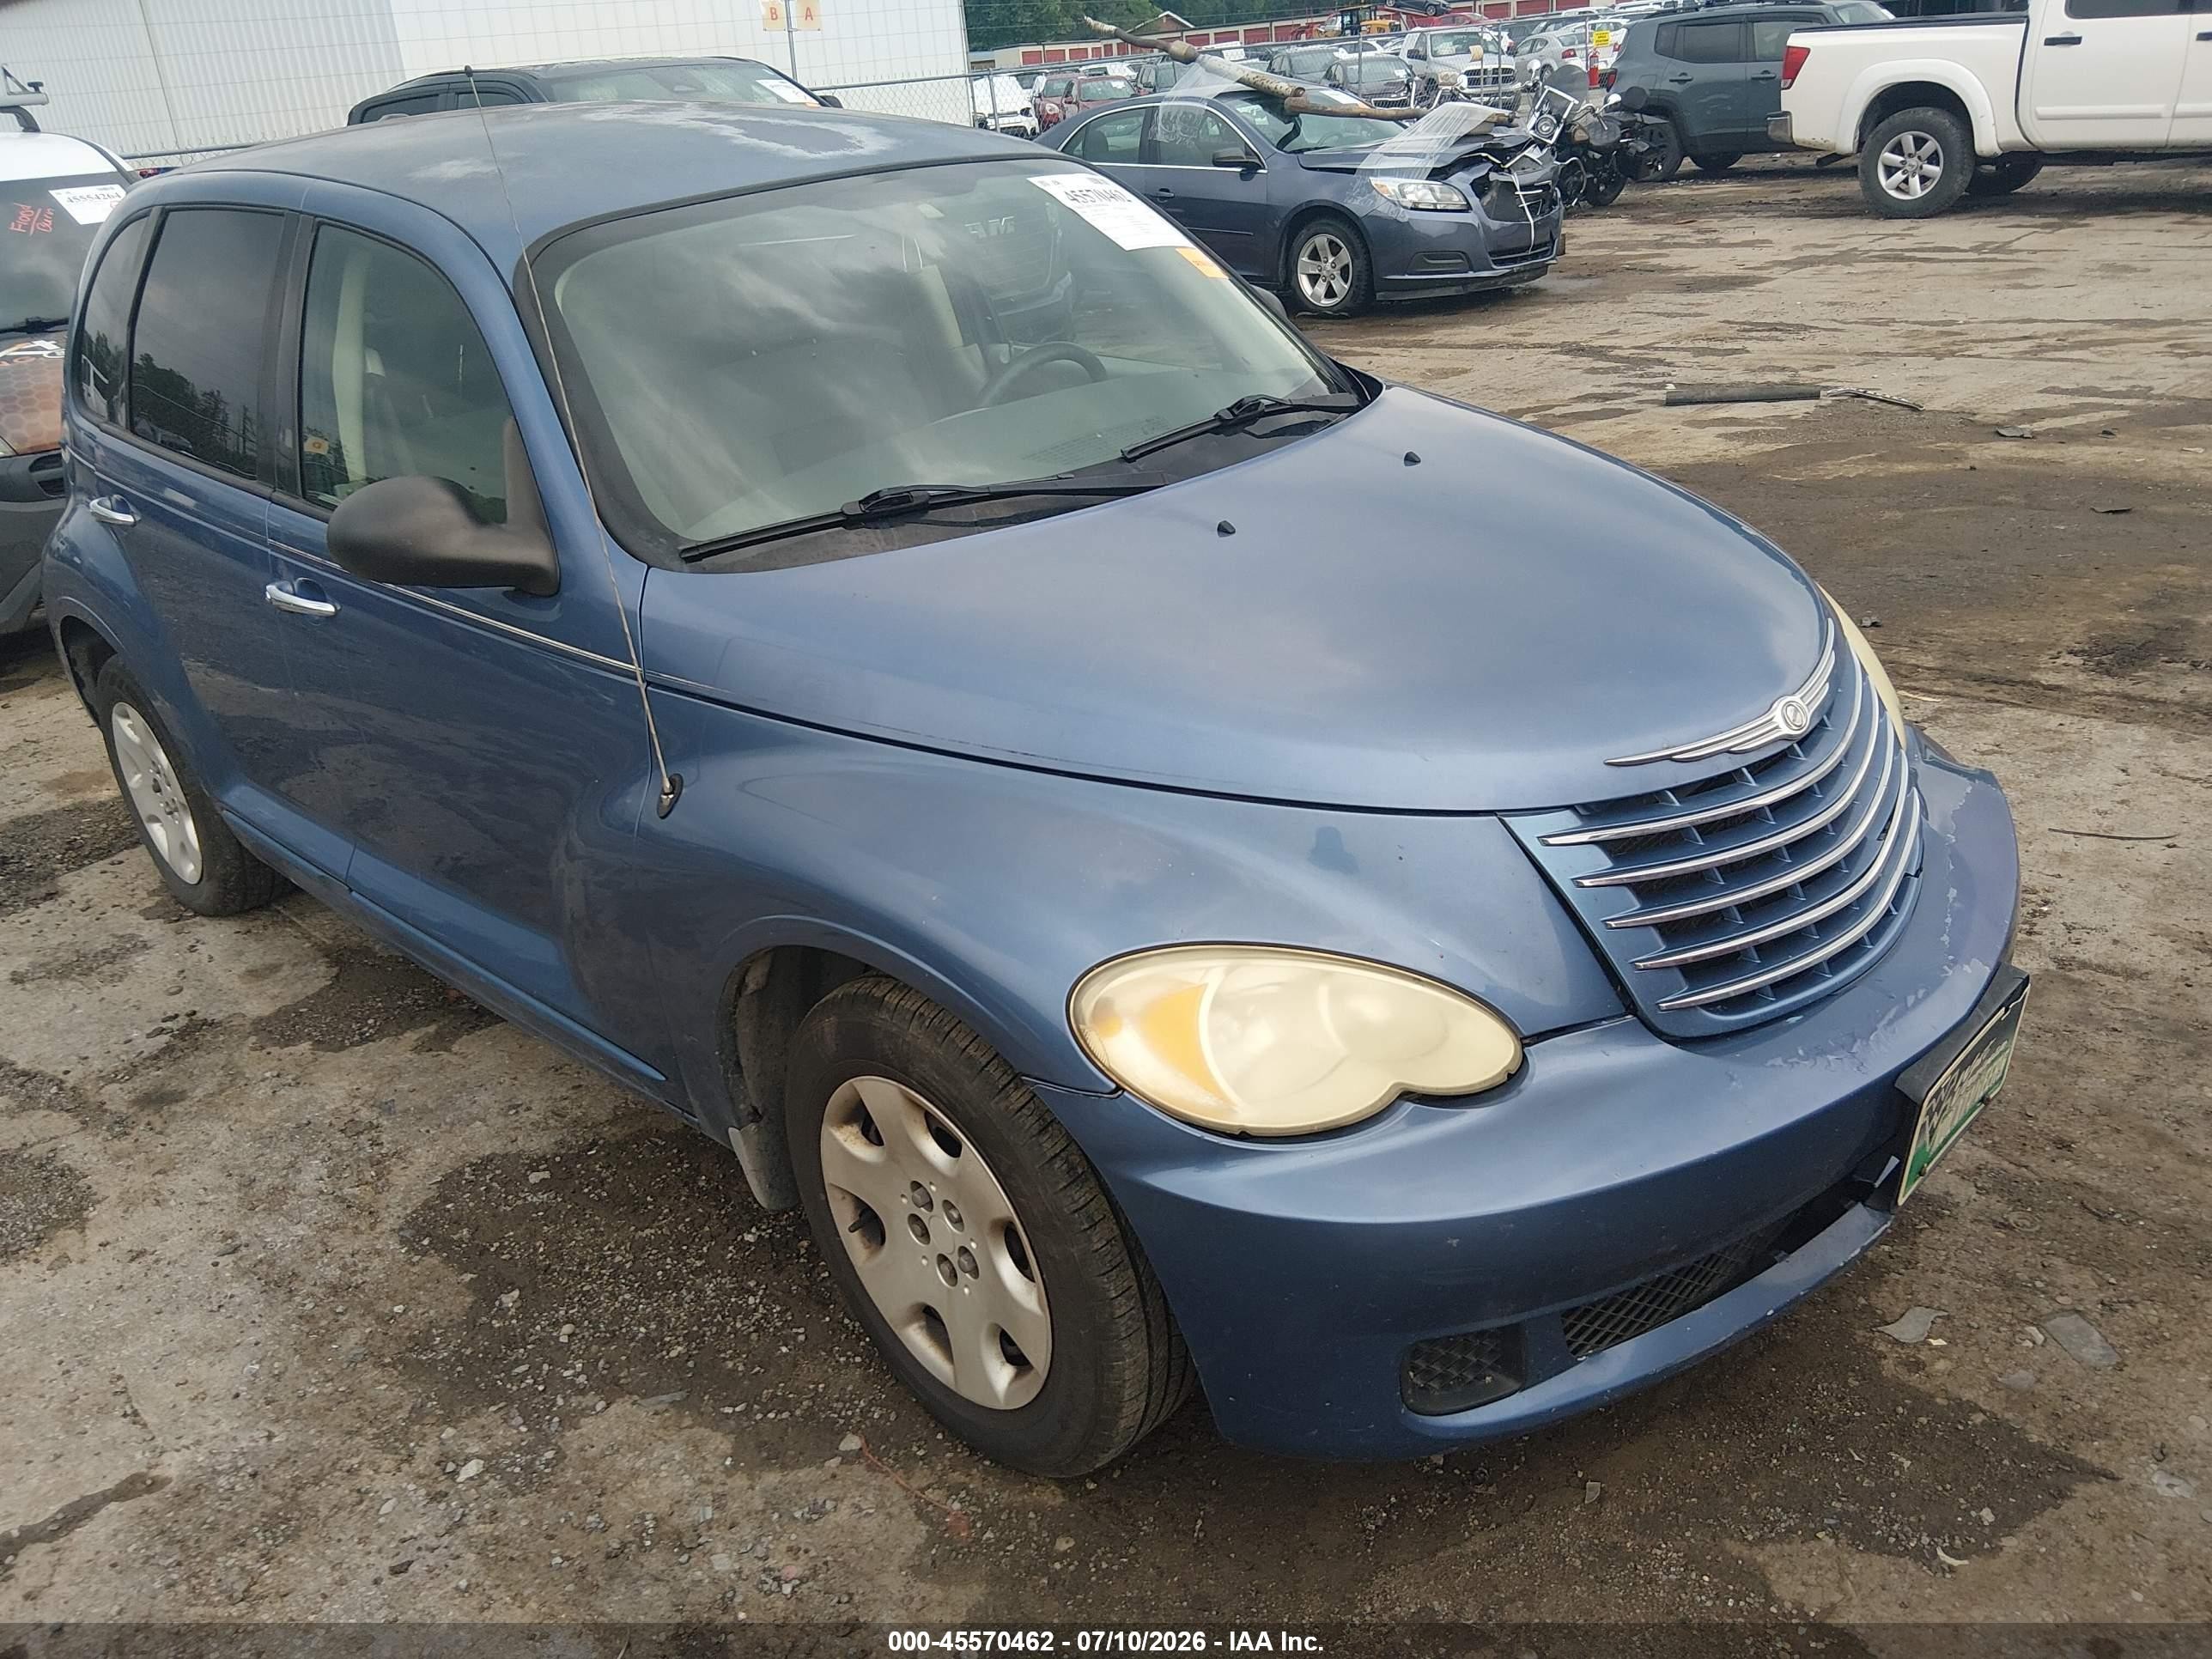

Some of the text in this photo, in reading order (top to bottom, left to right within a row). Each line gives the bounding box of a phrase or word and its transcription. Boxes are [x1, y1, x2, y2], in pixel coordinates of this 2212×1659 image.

[769, 6, 779, 21] B
[805, 6, 814, 21] A
[1064, 188, 1133, 204] 45570462
